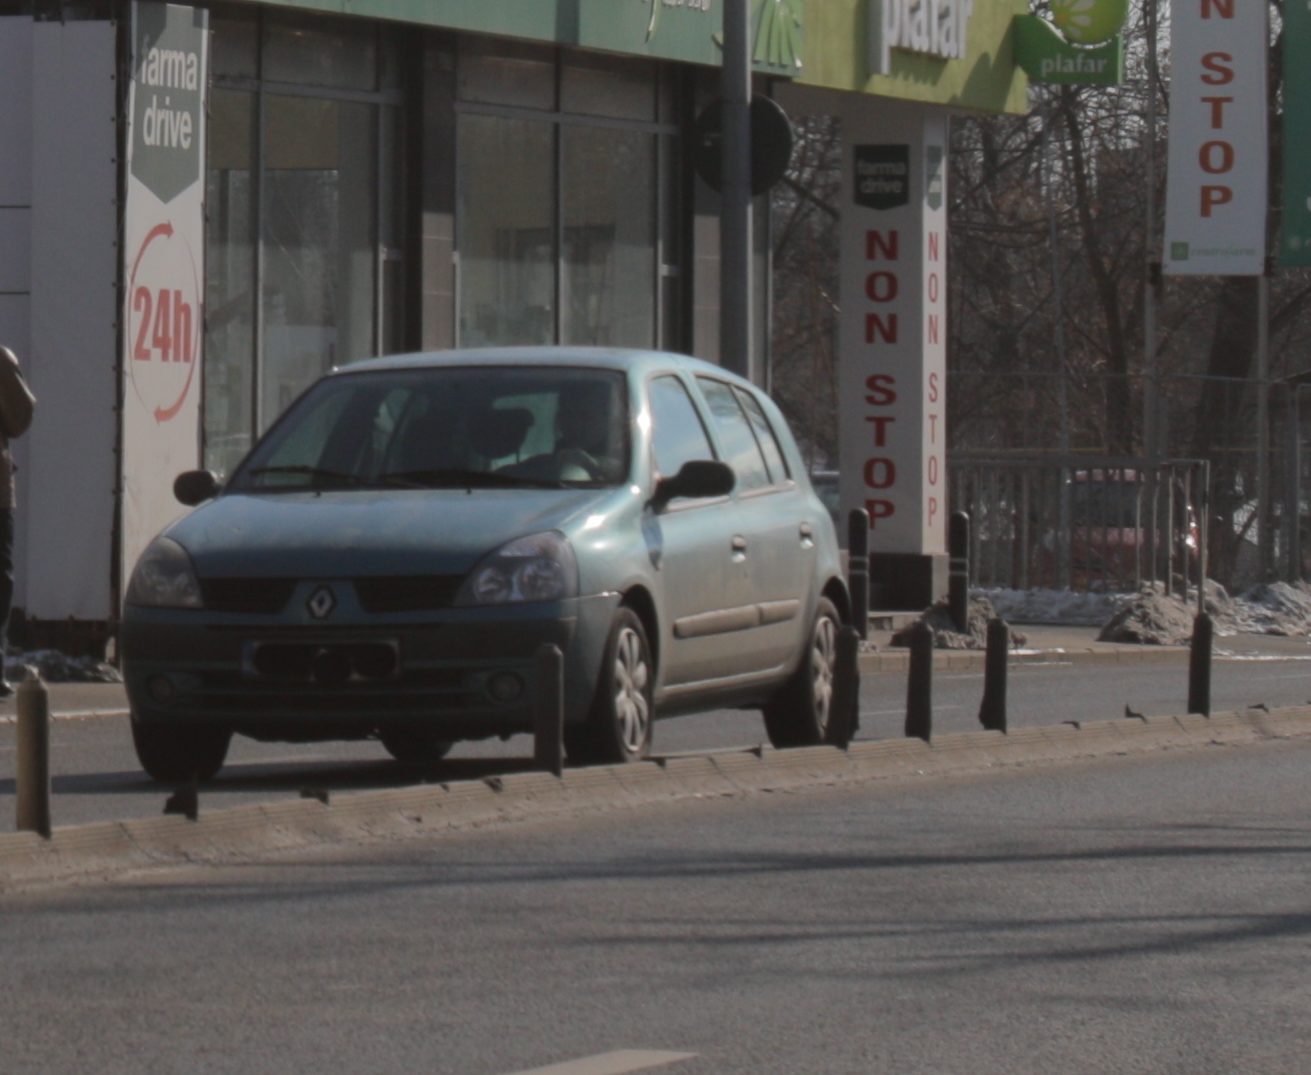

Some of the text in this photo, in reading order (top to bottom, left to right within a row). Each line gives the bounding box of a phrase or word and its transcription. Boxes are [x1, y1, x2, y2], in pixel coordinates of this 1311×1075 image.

[141, 33, 198, 91] farma
[1041, 53, 1108, 78] plafar
[143, 94, 193, 150] drive
[1197, 51, 1235, 219] STOP
[133, 285, 194, 364] 24h
[863, 229, 899, 531] NON STOP
[927, 231, 939, 528] NON STOP
